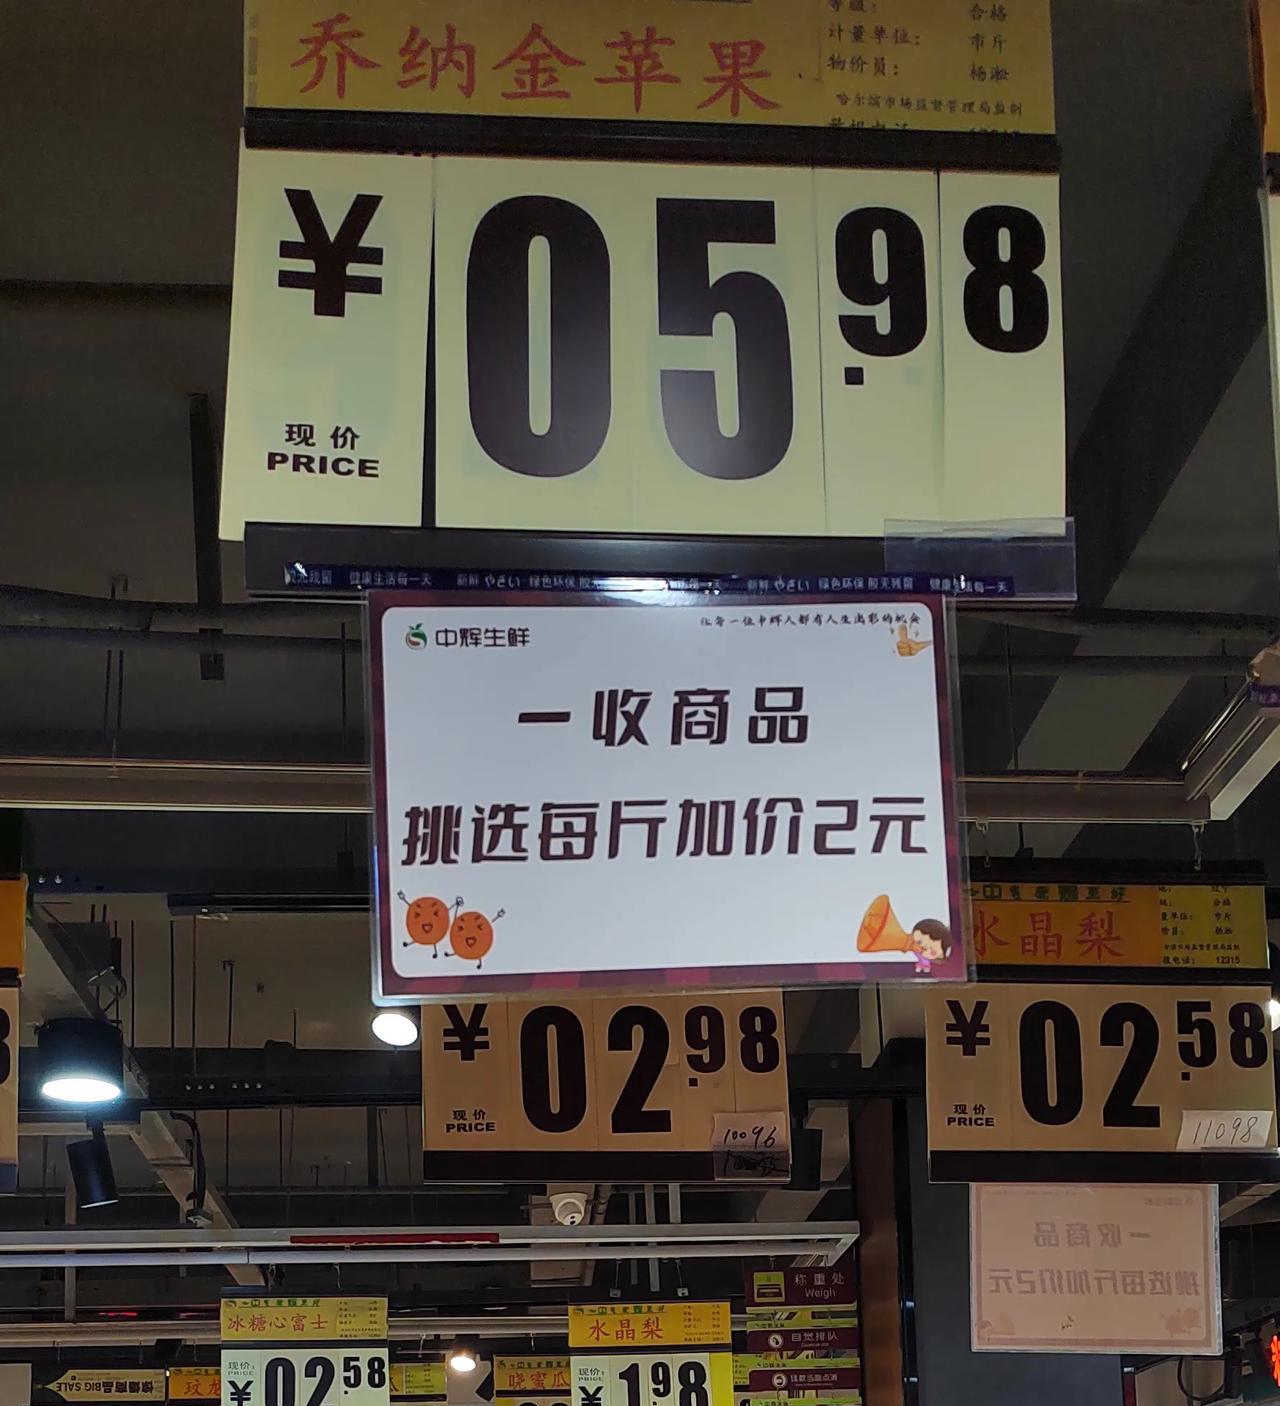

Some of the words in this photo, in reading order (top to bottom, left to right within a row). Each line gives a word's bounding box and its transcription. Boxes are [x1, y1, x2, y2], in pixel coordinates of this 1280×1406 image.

[969, 4, 1007, 22] 合格
[969, 34, 1006, 54] 市斤
[290, 12, 782, 118] 乔纳金苹果
[285, 423, 360, 451] 现价
[267, 452, 380, 479] PRICE
[435, 626, 531, 649] 中辉生鲜
[517, 686, 809, 747] 一收商品
[401, 796, 930, 866] 挑选每斤加价2元
[974, 909, 1126, 961] 水晶梨
[452, 1109, 487, 1121] 现价
[953, 1103, 986, 1115] 现价
[445, 1122, 496, 1134] PRICE
[947, 1116, 995, 1128] PRICE
[1193, 1115, 1259, 1144] 11098
[723, 1126, 776, 1150] 10096
[794, 1272, 845, 1286] 称重处
[805, 1287, 836, 1299] Weigh
[227, 1314, 329, 1332] 冰糖心富士
[588, 1316, 665, 1342] 水晶梨
[791, 1331, 839, 1342] 自觉排队
[56, 1382, 82, 1392] SALE
[508, 1371, 571, 1391] 晓蜜瓜
